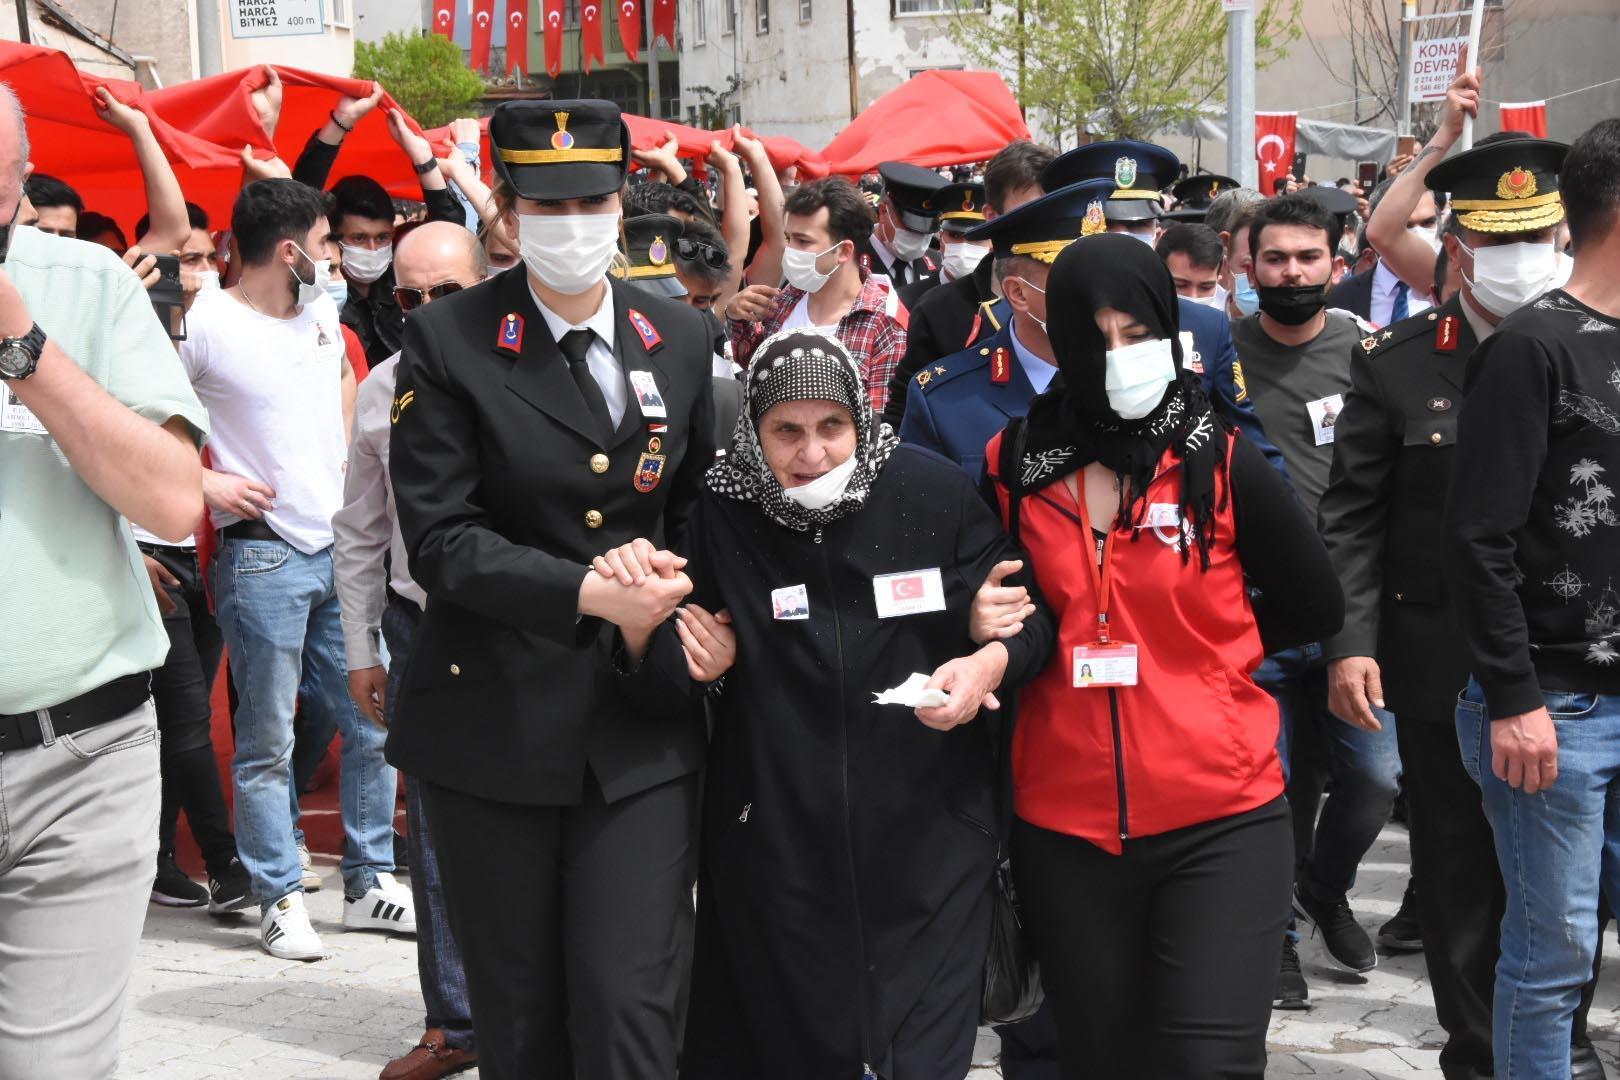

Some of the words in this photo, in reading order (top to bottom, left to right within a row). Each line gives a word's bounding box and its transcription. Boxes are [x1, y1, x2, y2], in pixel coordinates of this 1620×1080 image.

[239, 7, 276, 17] HARCA
[287, 17, 304, 26] 400
[305, 17, 315, 25] m
[1413, 59, 1458, 74] DEVRA
